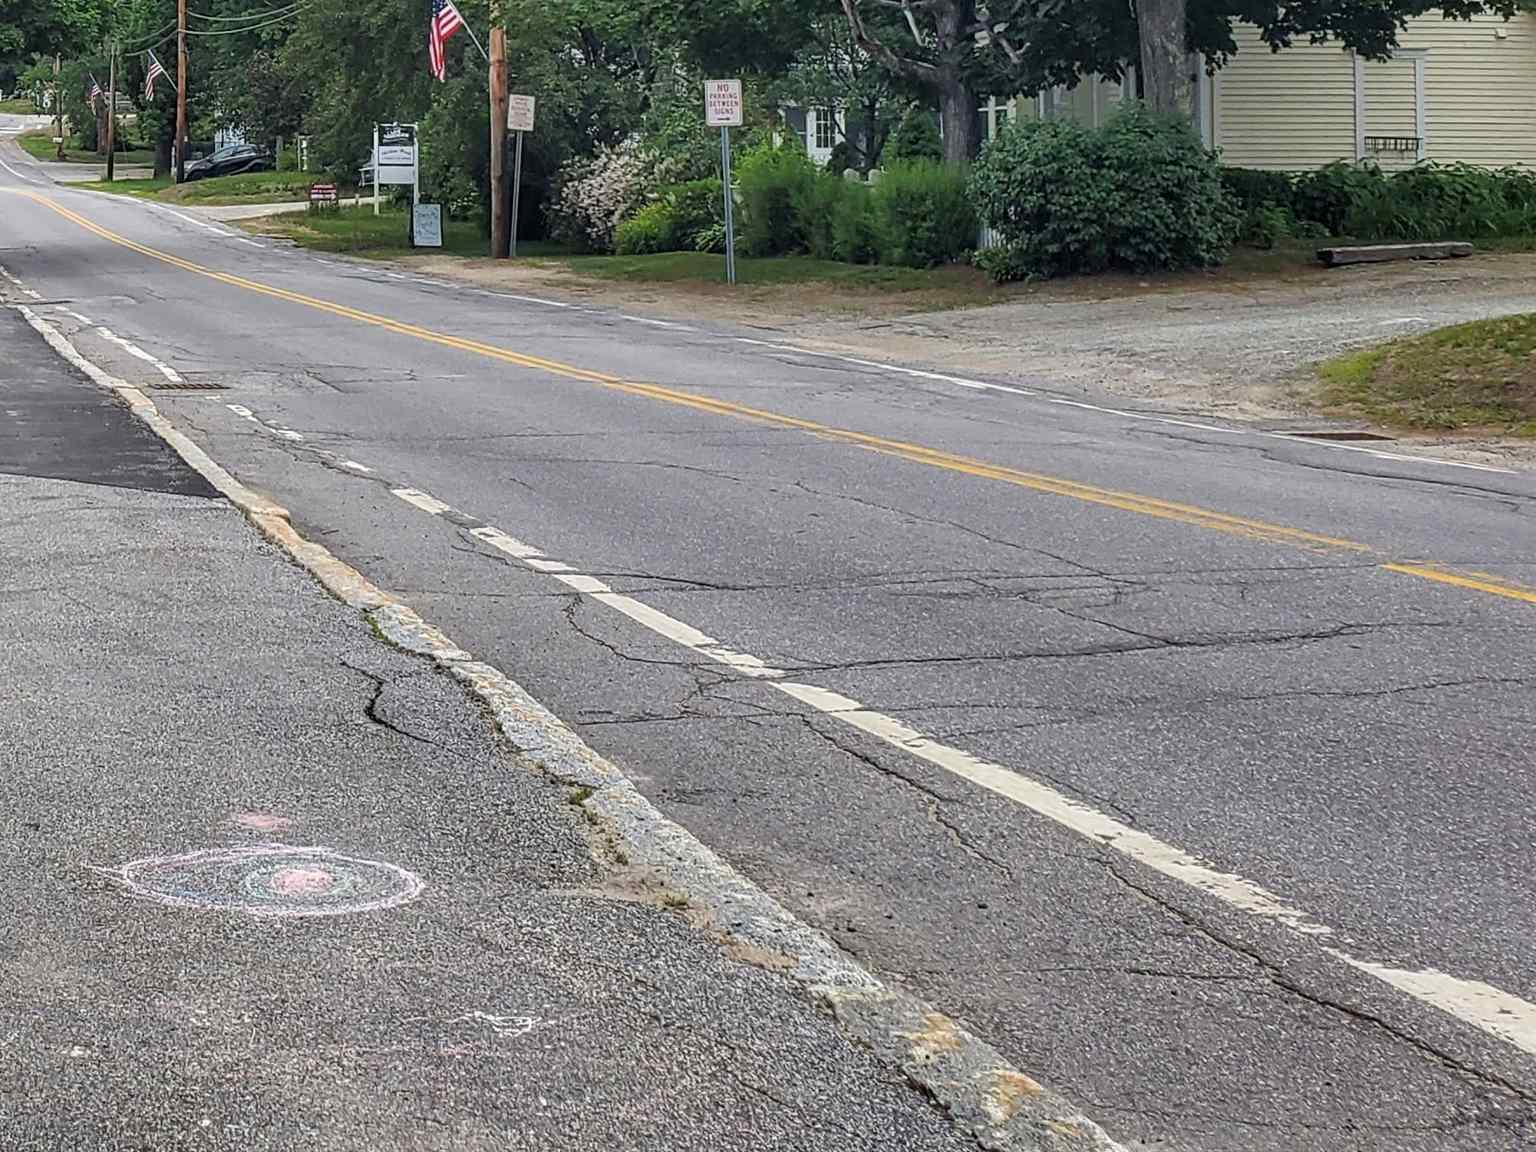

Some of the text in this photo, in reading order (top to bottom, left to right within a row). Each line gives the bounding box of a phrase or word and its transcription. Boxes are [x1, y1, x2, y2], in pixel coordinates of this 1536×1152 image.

[716, 83, 729, 92] NO
[709, 100, 739, 108] BETWEEN
[714, 107, 734, 115] SIGNS
